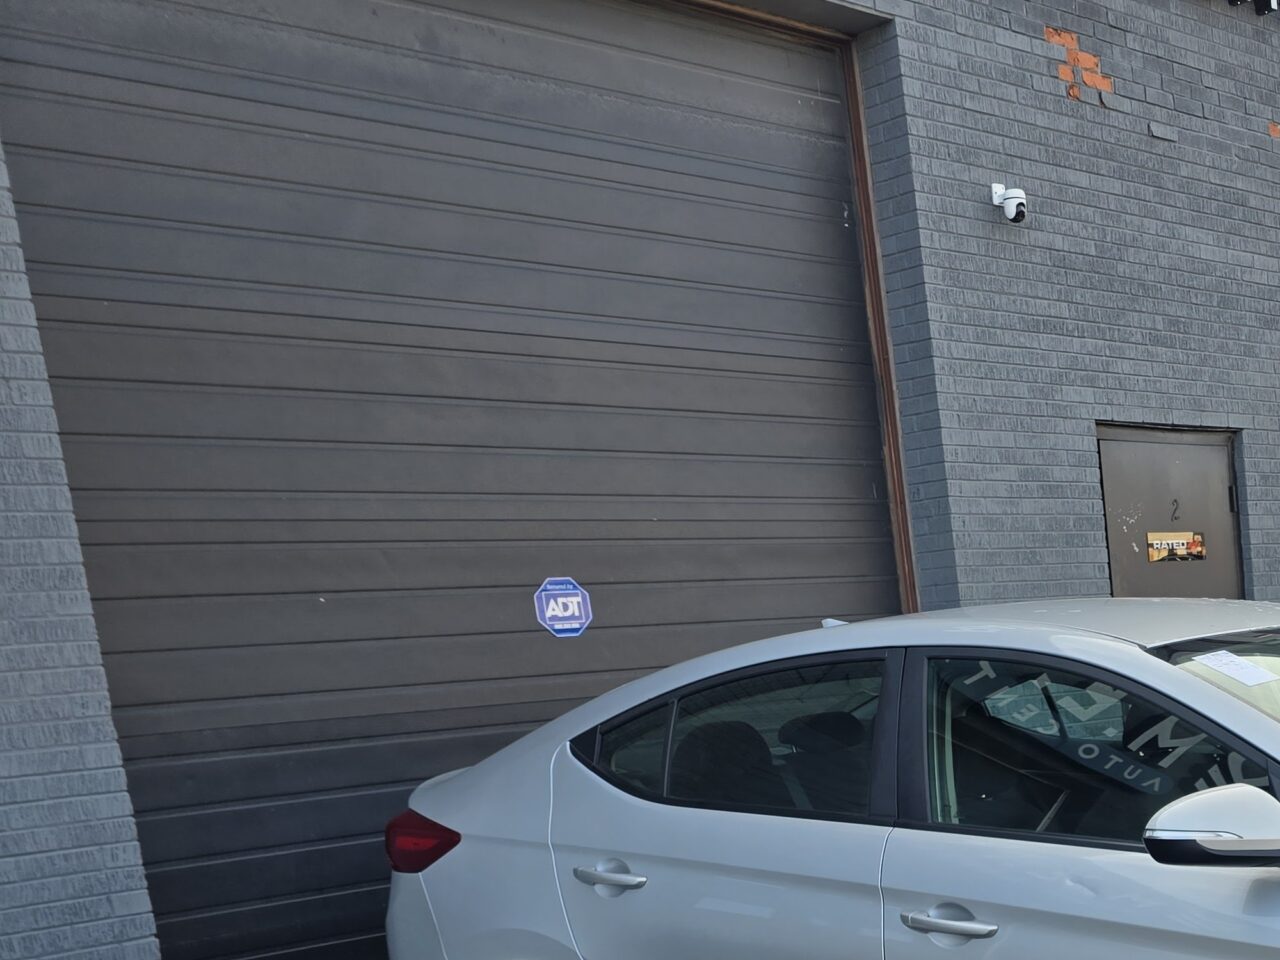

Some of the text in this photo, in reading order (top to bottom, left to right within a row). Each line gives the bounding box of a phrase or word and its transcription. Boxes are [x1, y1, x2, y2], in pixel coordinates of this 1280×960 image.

[1170, 498, 1181, 522] 2
[1153, 540, 1187, 549] RATED
[546, 596, 581, 618] ADT
